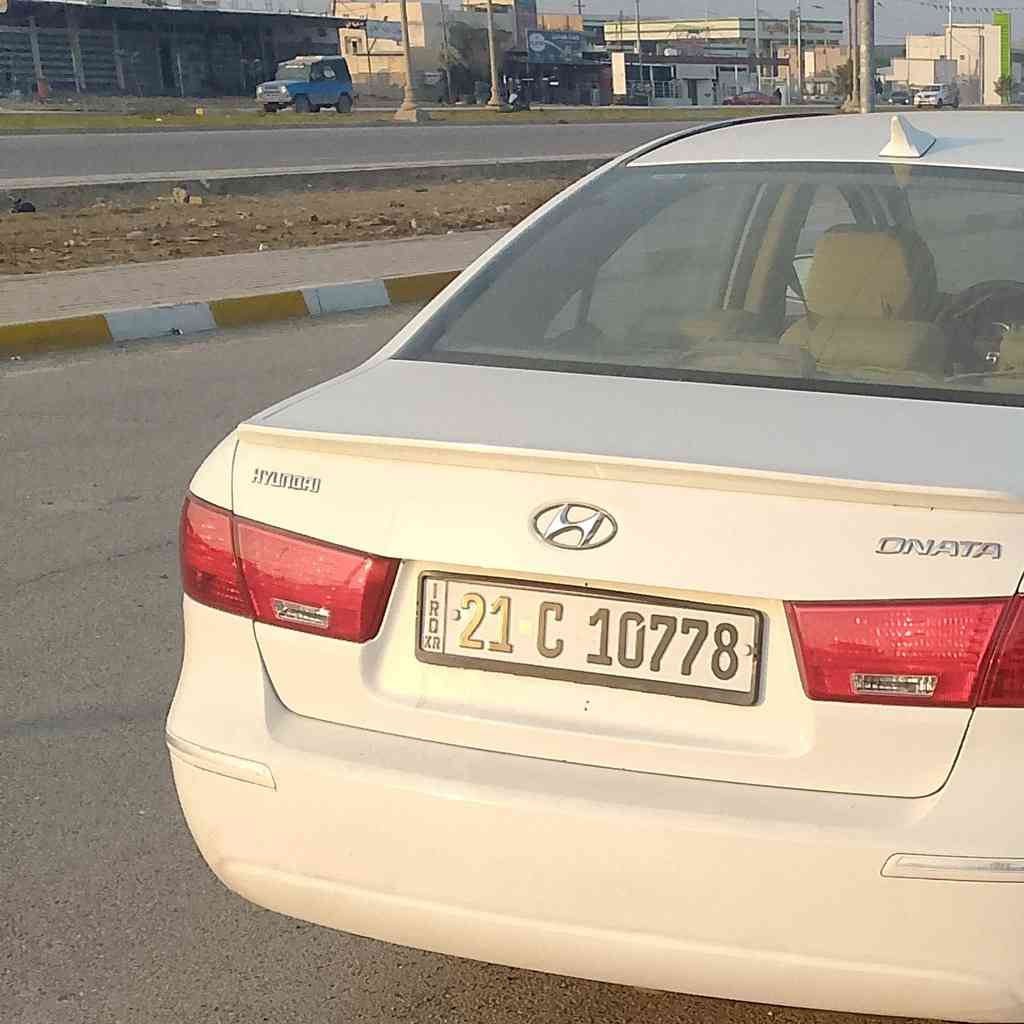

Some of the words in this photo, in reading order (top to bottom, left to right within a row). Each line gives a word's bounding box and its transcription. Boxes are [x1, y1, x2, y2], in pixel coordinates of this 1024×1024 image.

[875, 536, 1001, 560] ONATA
[458, 592, 514, 653] 21
[536, 601, 564, 659] C
[586, 607, 739, 681] 10778
